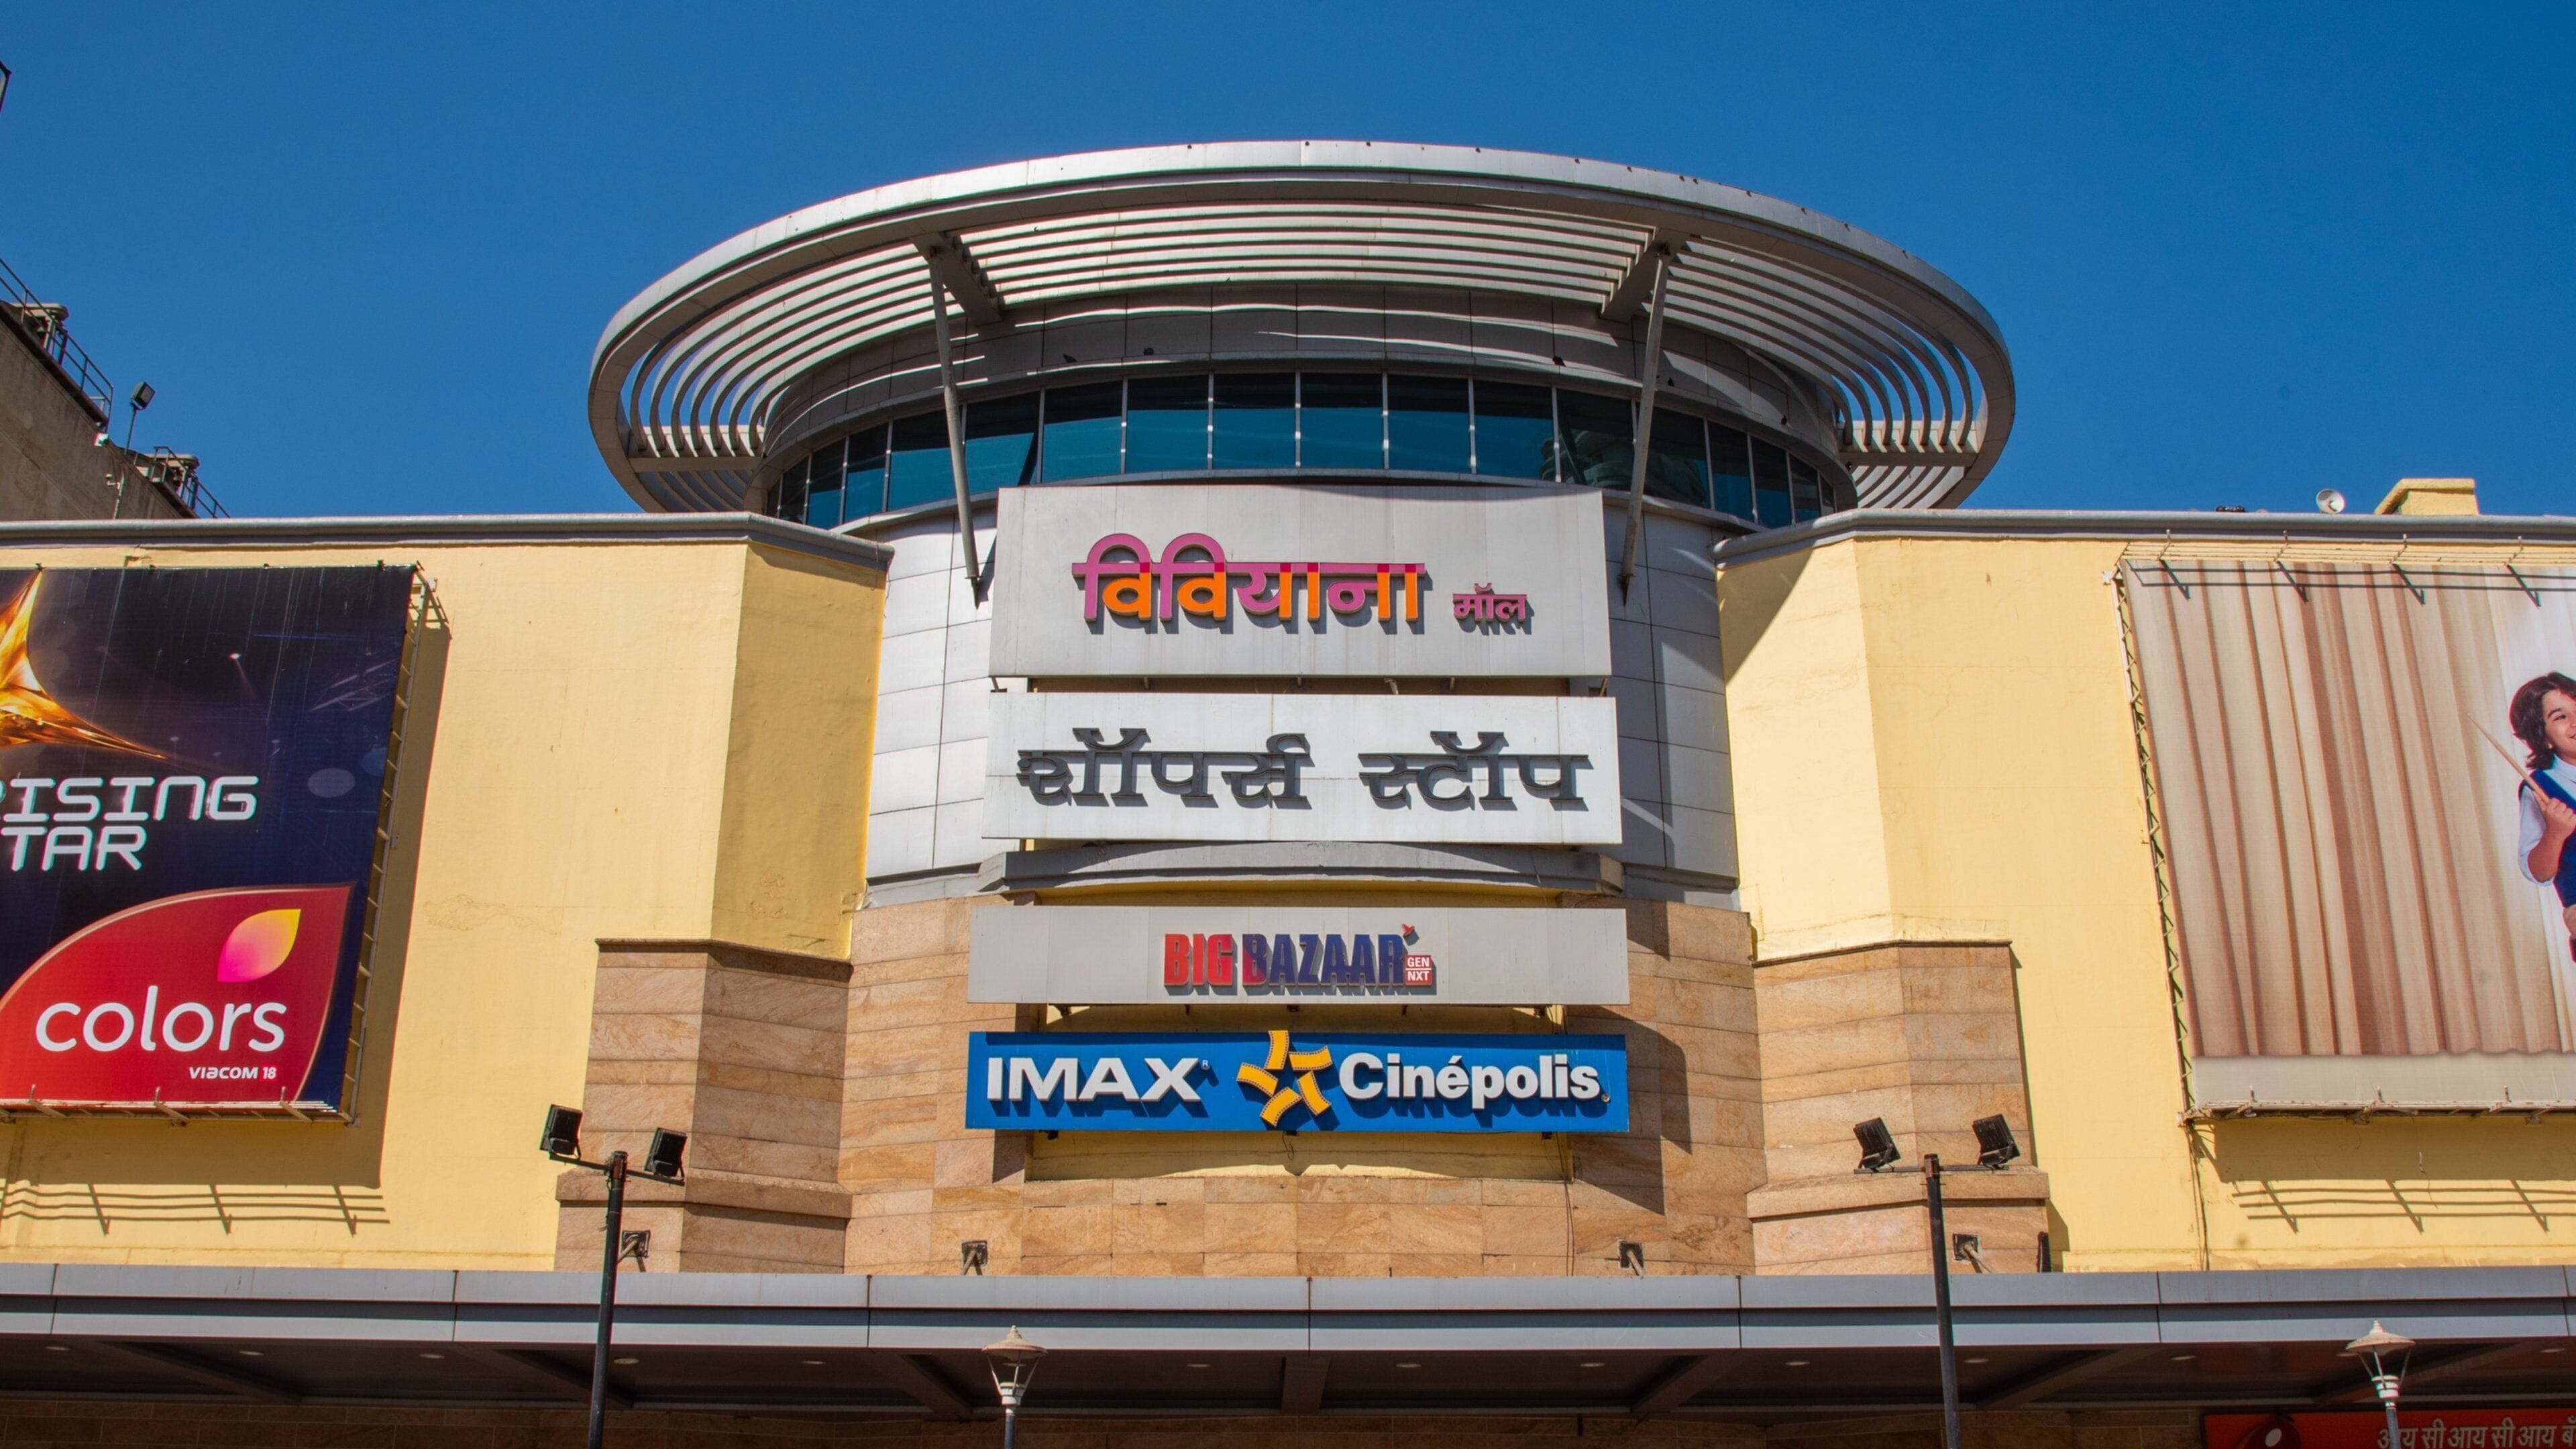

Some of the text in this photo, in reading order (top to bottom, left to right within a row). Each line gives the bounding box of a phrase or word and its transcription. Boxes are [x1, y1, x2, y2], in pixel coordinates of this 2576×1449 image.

[1072, 533, 1527, 623] विवियाना मॉल
[1016, 728, 1589, 804] शॉपर्स स्टॉप
[0, 776, 260, 821] ISING
[1164, 933, 1405, 986] BIG BAZAAR
[1407, 957, 1430, 967] GEN
[1407, 971, 1430, 981] NXT
[36, 985, 287, 1052] colors
[262, 1067, 277, 1079] 18
[1340, 1052, 1601, 1110] Cinépolis
